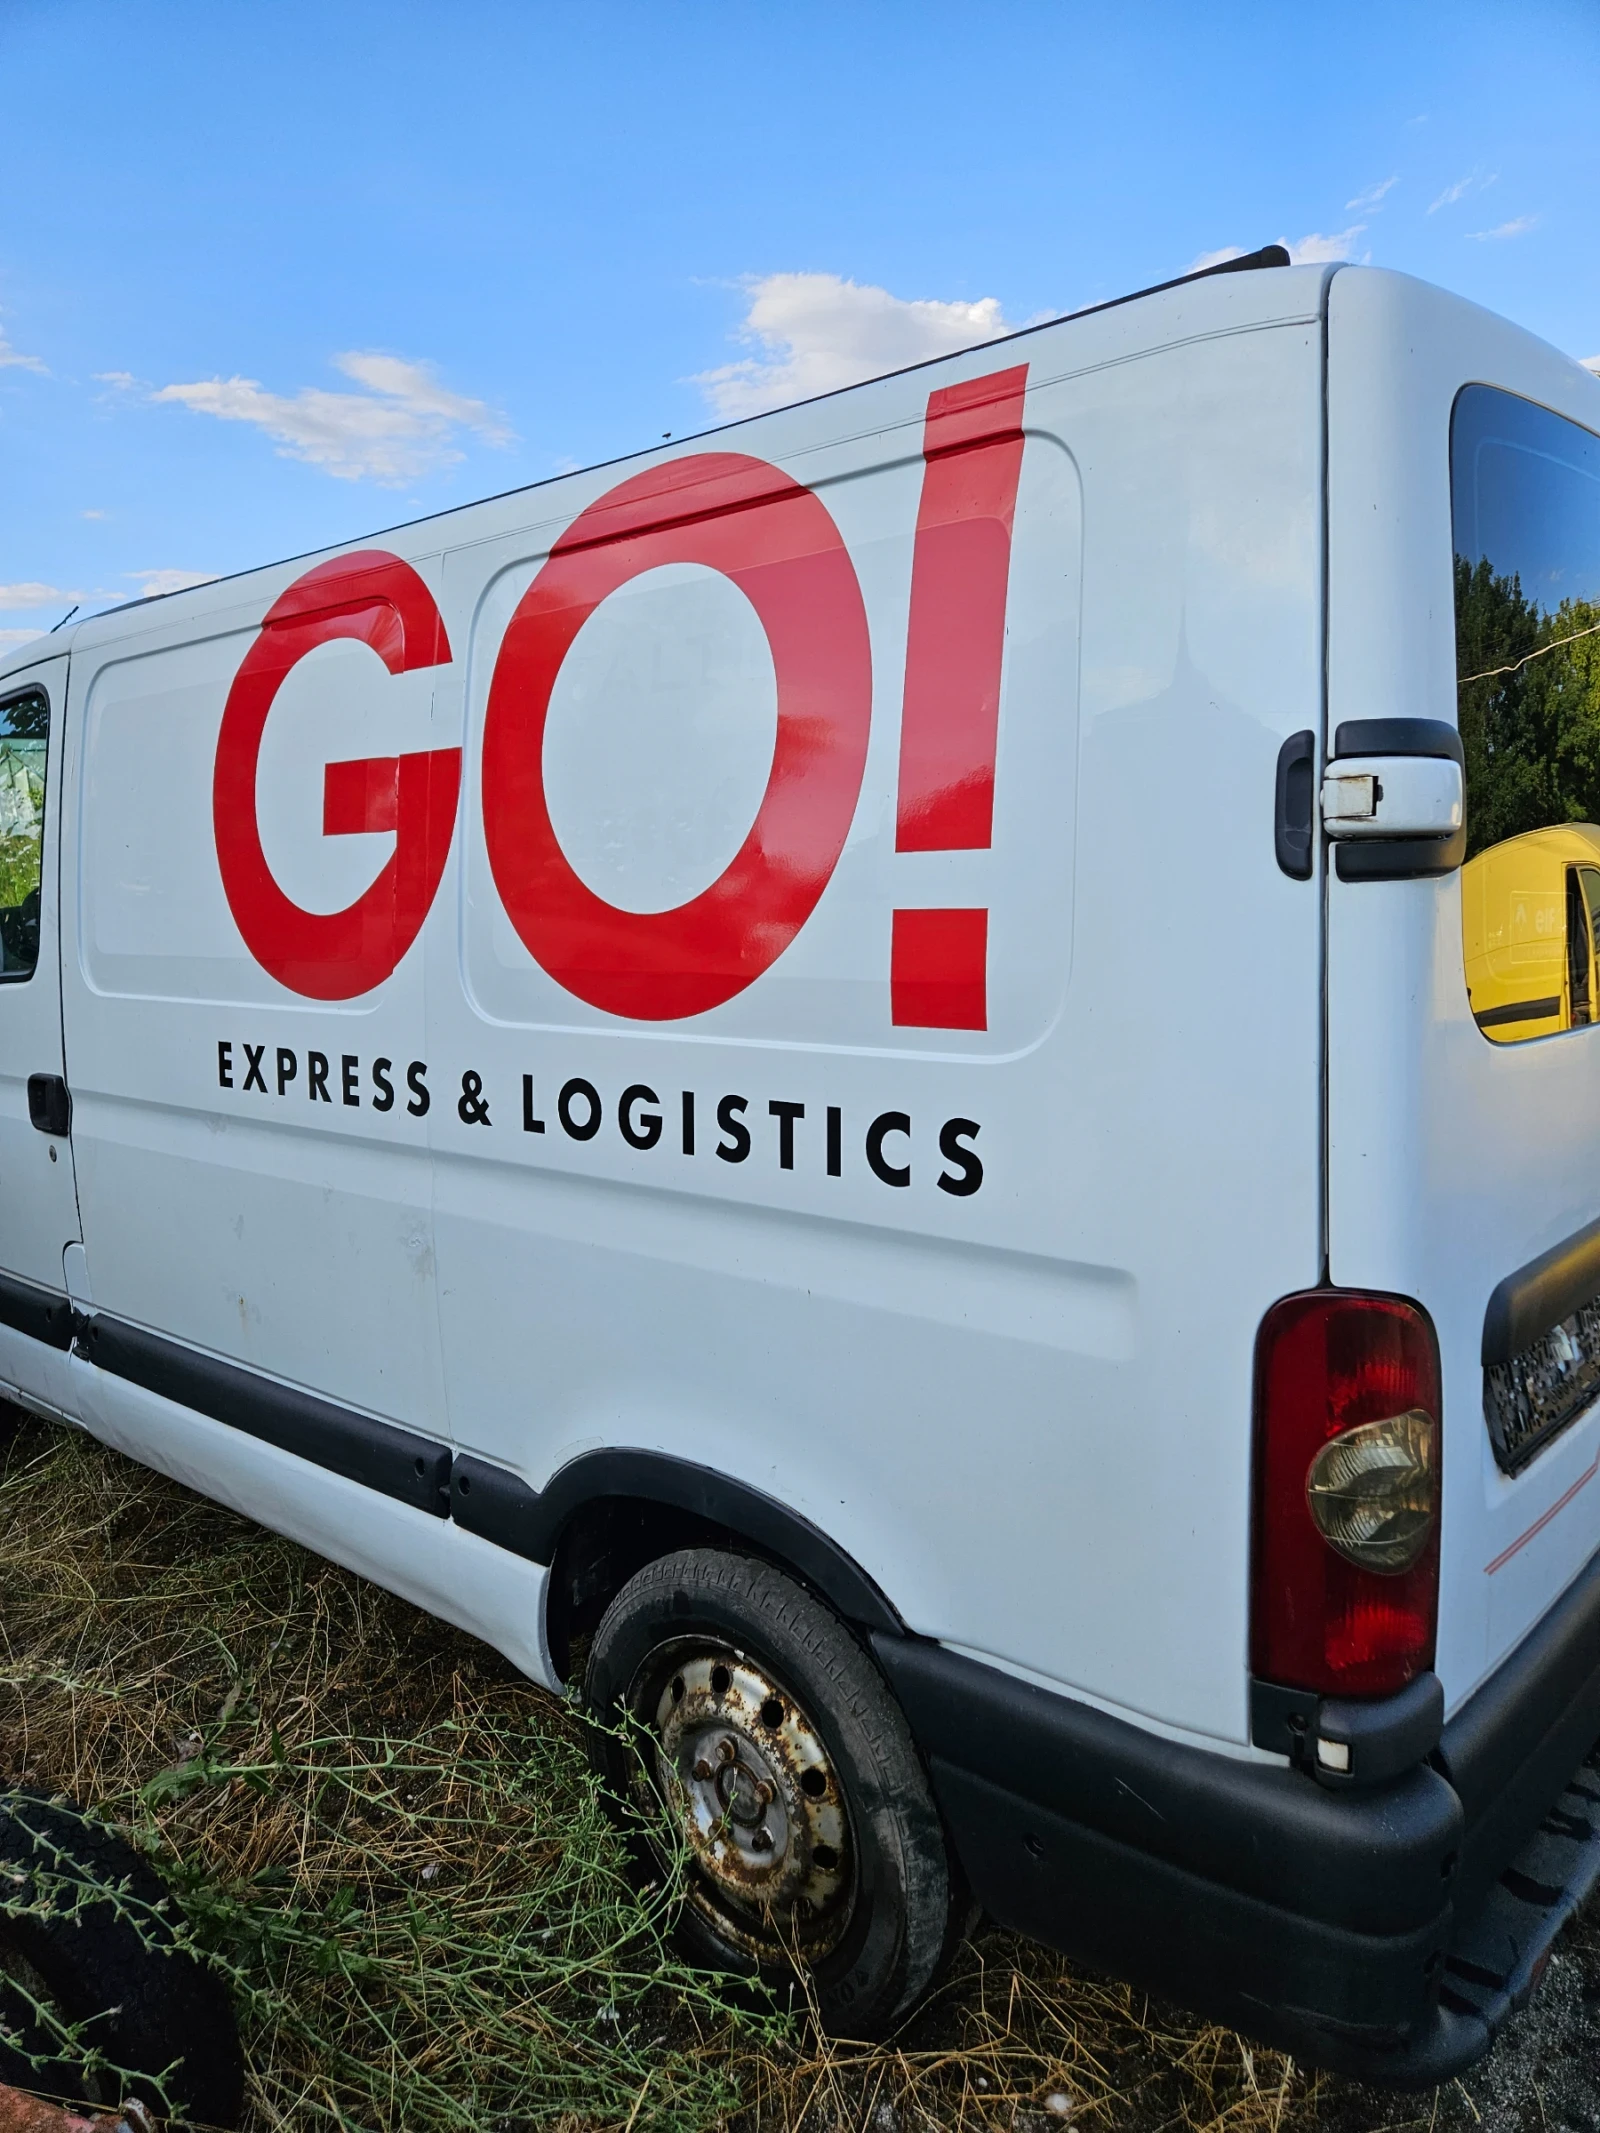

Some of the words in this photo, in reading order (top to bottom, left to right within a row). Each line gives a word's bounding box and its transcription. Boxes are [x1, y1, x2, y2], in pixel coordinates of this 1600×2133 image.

[213, 364, 1030, 1031] GO!
[217, 1040, 431, 1118] EXPRESS
[457, 1069, 493, 1127] &
[522, 1073, 984, 1197] LOGISTICS
